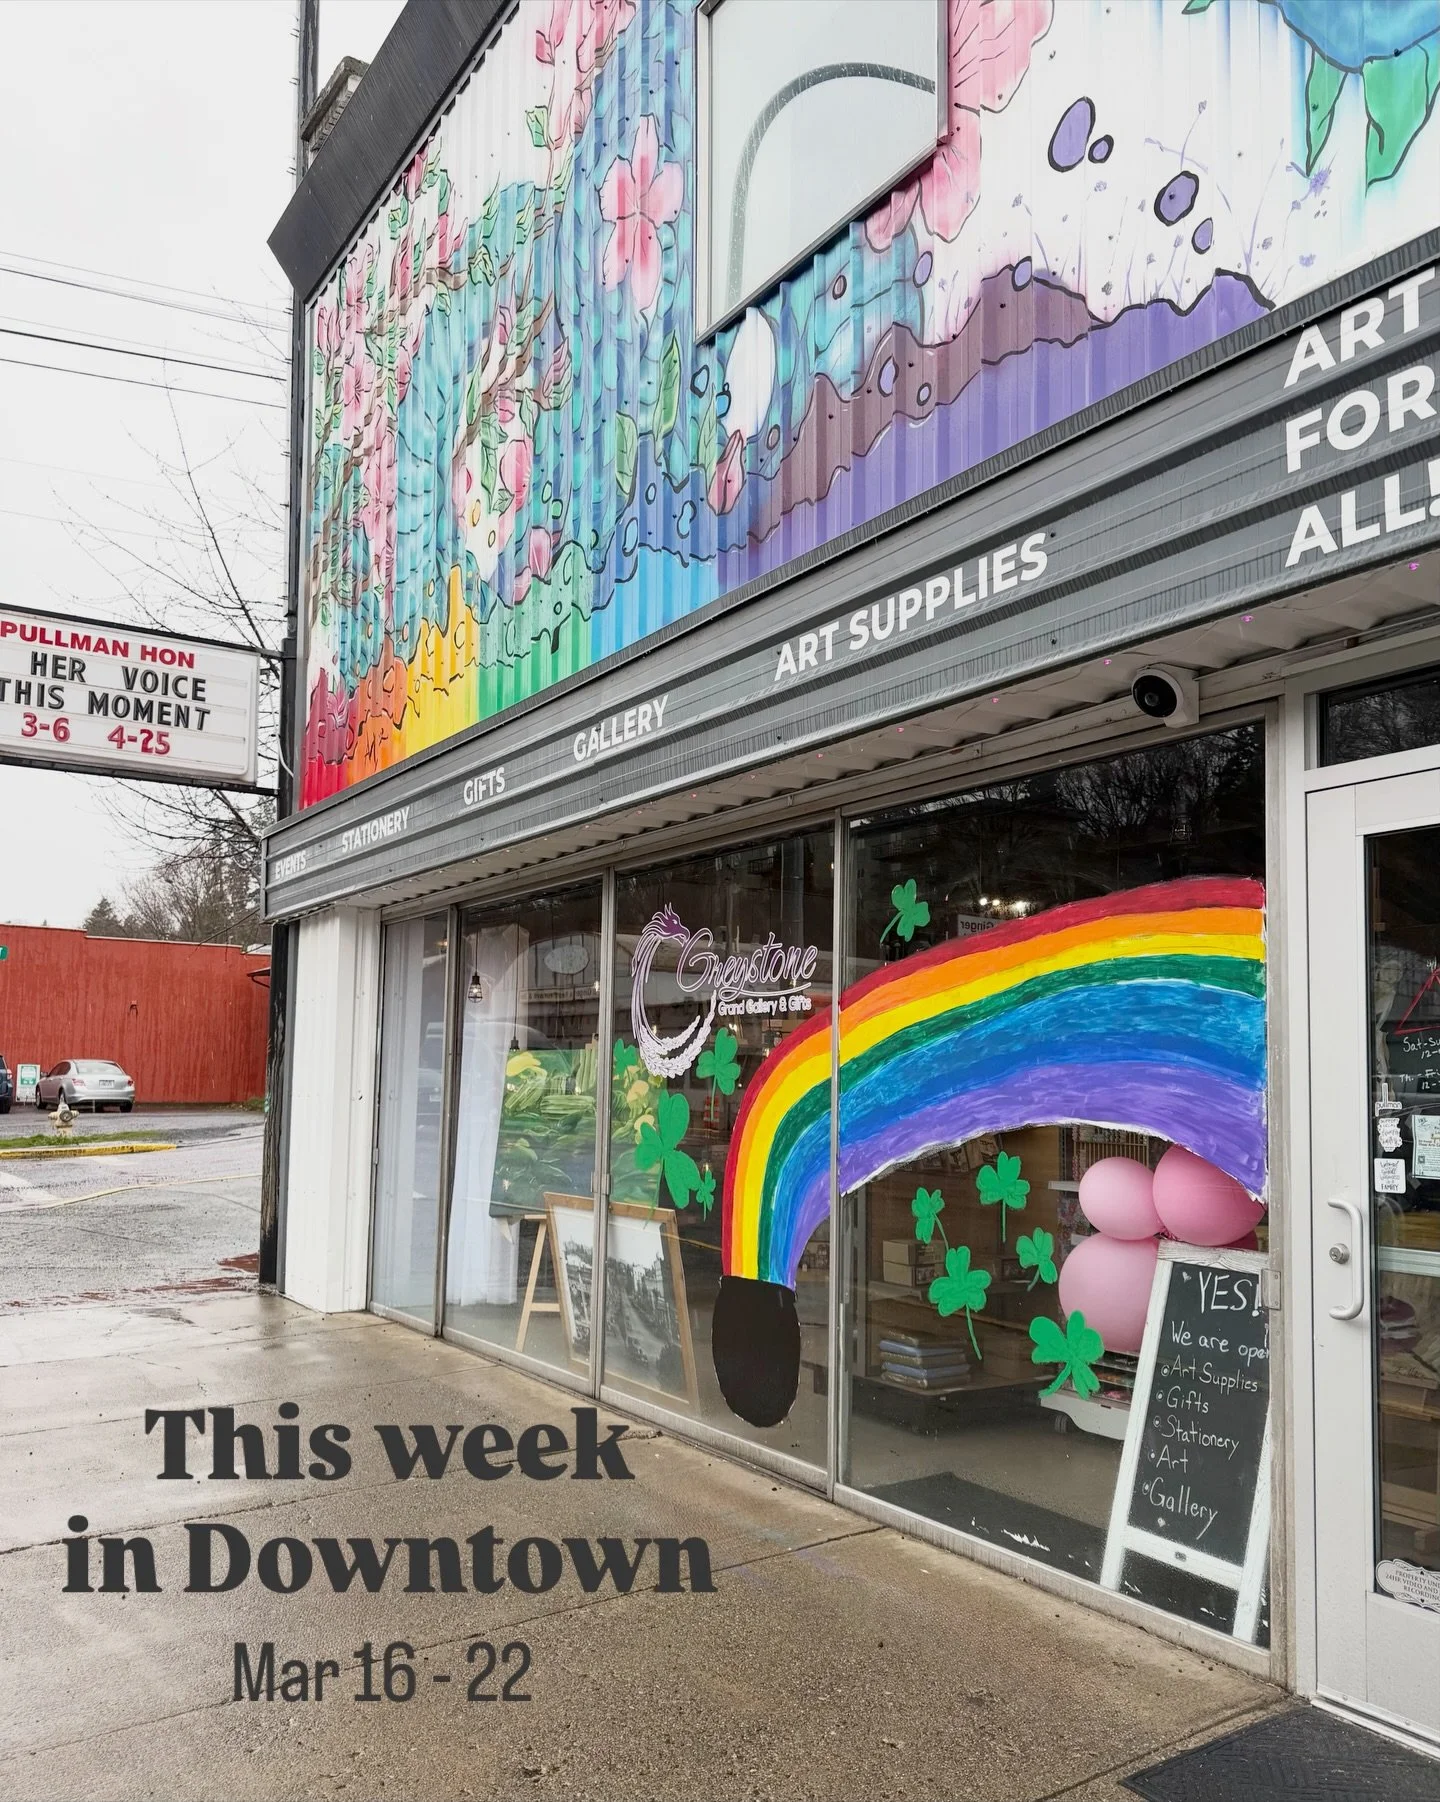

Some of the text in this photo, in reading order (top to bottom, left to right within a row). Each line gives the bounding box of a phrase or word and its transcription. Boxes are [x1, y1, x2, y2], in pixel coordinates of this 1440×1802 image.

[1283, 266, 1436, 389] ART
[1285, 364, 1437, 474] FOR
[1285, 457, 1440, 568] ALL!
[774, 532, 1048, 681] ART SUPPLIES
[0, 620, 195, 669] PULLMAN HON
[31, 651, 206, 702] HER VOICE
[0, 677, 210, 731] THIS MOMENT
[21, 712, 170, 755] 3-6 4-25
[573, 695, 669, 761] GALLERY
[463, 766, 506, 806] GIFTS
[341, 806, 410, 853] STATIONERY
[275, 850, 306, 879] EVENTS
[676, 927, 818, 1001] Greystone
[718, 995, 812, 1016] Grand Gallery & Gifts
[1199, 1271, 1260, 1317] YES!
[1172, 1320, 1192, 1346] We
[1198, 1335, 1229, 1353] are
[1170, 1354, 1258, 1396] Art Supplies
[1166, 1385, 1209, 1414] Gifts
[1156, 1444, 1189, 1474] Art
[1161, 1414, 1240, 1461] Stationery
[1150, 1476, 1218, 1541] Gallery
[1395, 1570, 1427, 1584] PROPERTY
